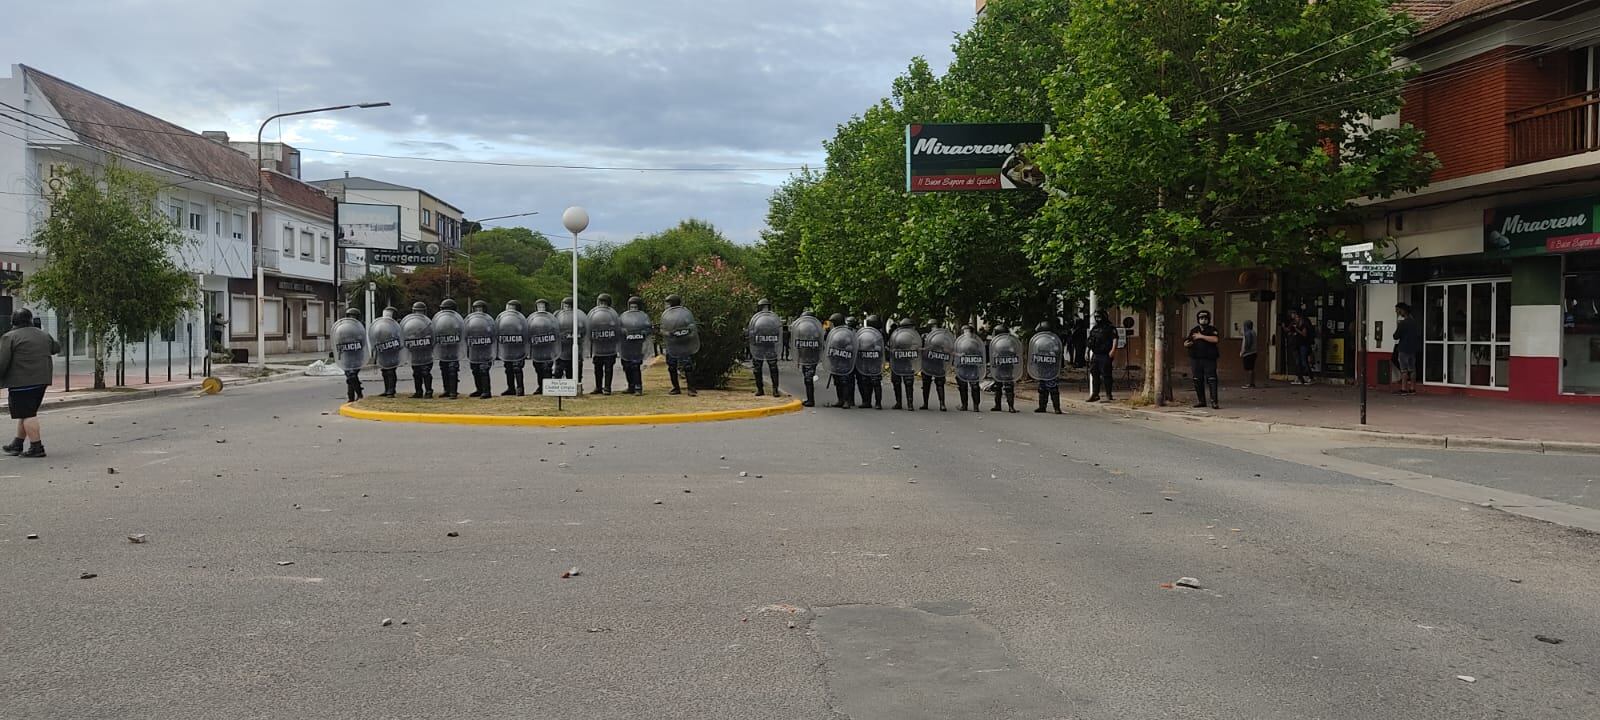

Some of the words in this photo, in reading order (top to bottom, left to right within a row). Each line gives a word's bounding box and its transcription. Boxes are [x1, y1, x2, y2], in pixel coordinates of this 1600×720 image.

[914, 138, 1014, 155] Miracrem
[1501, 214, 1586, 235] Miracrem
[374, 254, 436, 264] emergencia
[437, 336, 460, 344] POLICIA
[500, 335, 523, 344] POLICIA
[532, 335, 556, 344] POLICIA
[592, 330, 615, 340] POLICIA
[376, 340, 400, 352] POLICIA
[406, 339, 430, 348] POLICIA
[468, 336, 492, 346] POLICIA
[796, 340, 819, 348] POLICIA
[337, 342, 362, 352] POLICIA
[829, 348, 852, 359] POLICIA
[960, 356, 982, 364] POLICIA
[996, 356, 1018, 365] POLICIA
[1033, 354, 1056, 364] POLICIA
